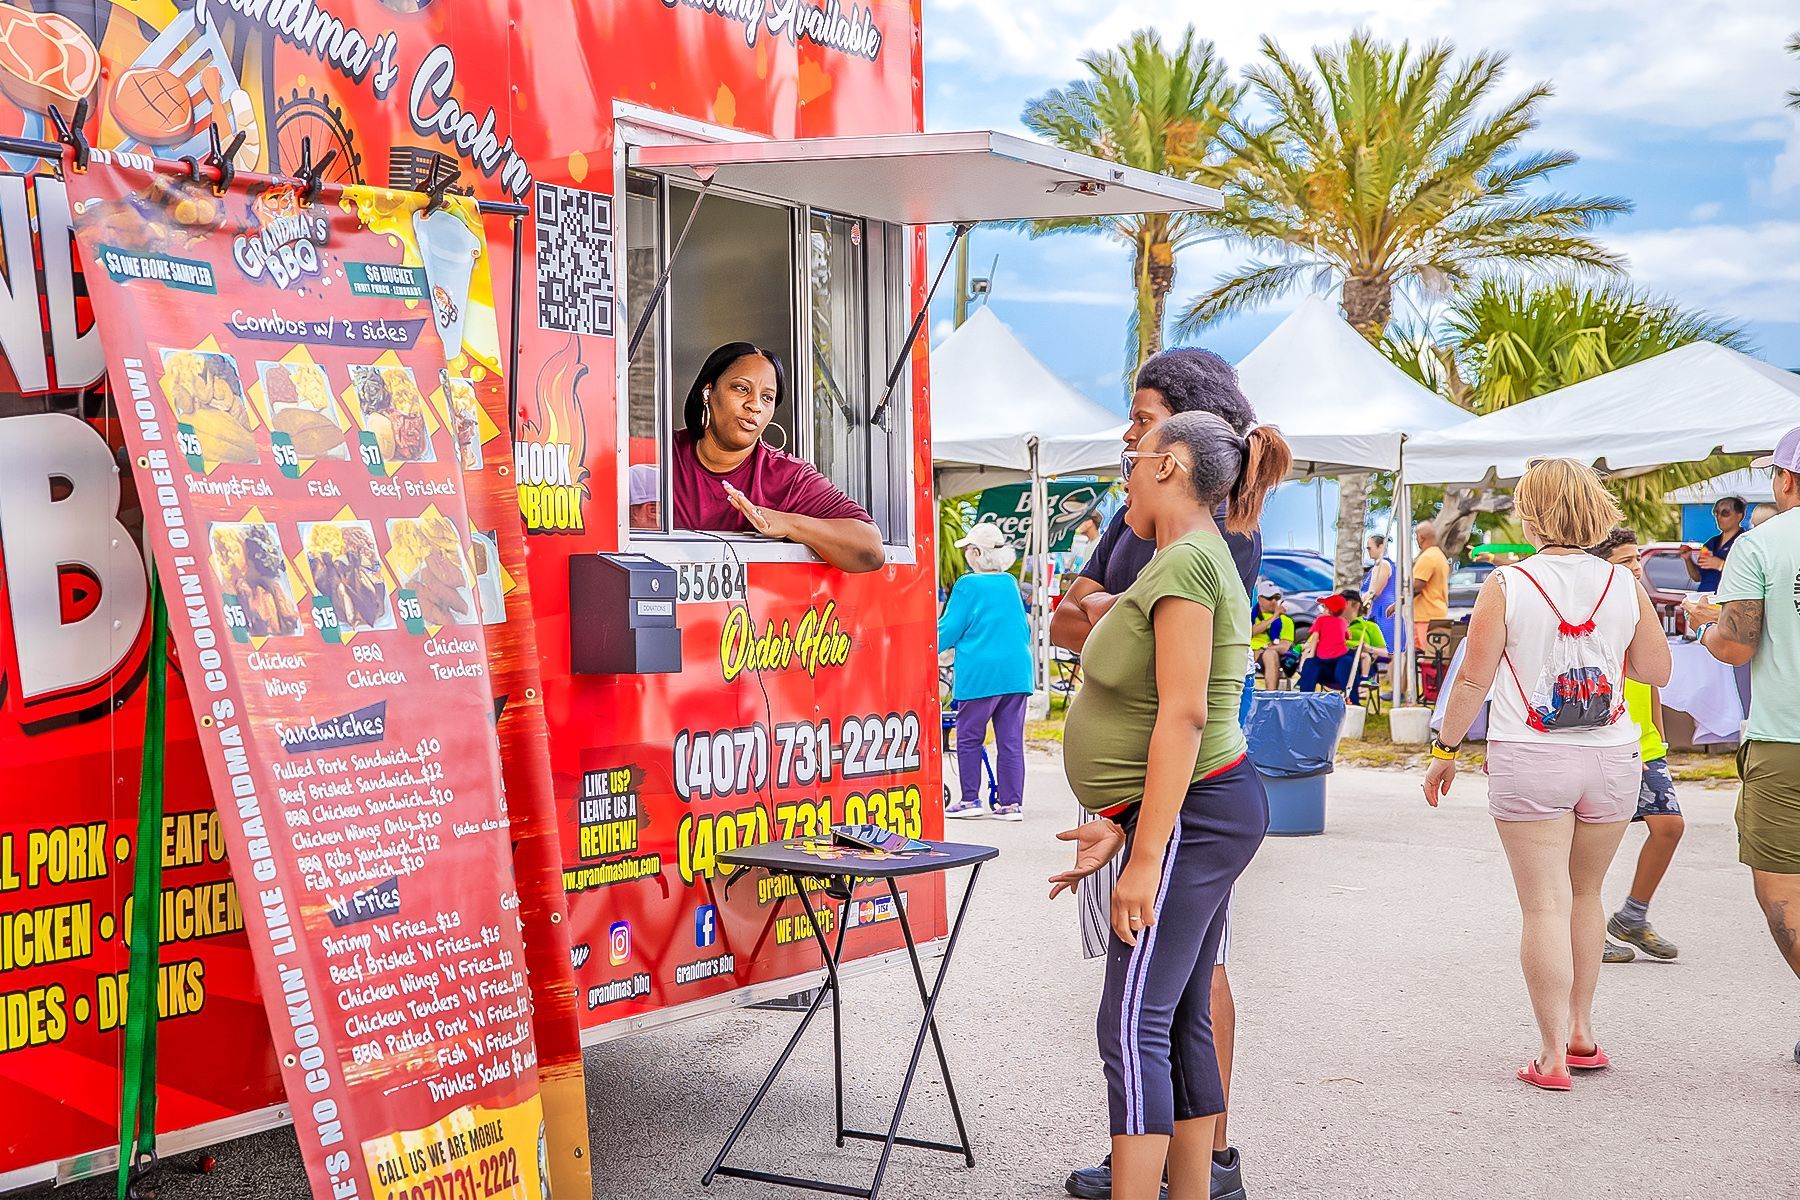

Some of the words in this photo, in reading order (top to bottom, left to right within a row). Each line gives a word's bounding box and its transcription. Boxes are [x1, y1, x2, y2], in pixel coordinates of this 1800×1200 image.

[120, 256, 141, 277] ONE
[140, 257, 171, 281] BONE
[170, 261, 213, 287] SAMPLER
[265, 239, 318, 290] BBQ
[379, 266, 415, 285] BUCKET
[231, 308, 308, 336] Combos
[313, 316, 334, 340] w/
[342, 320, 356, 340] 2
[362, 318, 408, 343] sides
[122, 357, 163, 442] NOW!
[177, 432, 202, 456] $25
[272, 444, 298, 467] $15
[147, 449, 191, 549] ORDER
[306, 478, 341, 497] Fish
[369, 475, 401, 501] Beef
[403, 478, 456, 498] Brisket
[527, 485, 584, 530] BOOK
[222, 604, 247, 629] $15
[311, 606, 338, 631] $15
[397, 598, 422, 621] $15
[352, 643, 385, 663] BBQ
[423, 637, 480, 657] Chicken
[719, 604, 794, 682] Order
[794, 599, 851, 679] Here
[247, 651, 307, 672] Chicken
[429, 659, 484, 681] Tenders
[264, 677, 308, 702] Wings
[346, 669, 408, 690] Chicken
[275, 713, 384, 747] Sandwiches
[272, 758, 316, 781] Pulled
[316, 758, 348, 776] Pork
[674, 725, 768, 799] (407)
[774, 712, 921, 787] 731-2222
[211, 698, 278, 883] GRANDMA'S
[278, 781, 307, 806] Beef
[308, 778, 354, 801] Brisket
[584, 772, 609, 798] LIKE
[609, 768, 631, 794] US?
[284, 808, 312, 828] BBQ
[311, 803, 365, 823] Chicken
[579, 797, 612, 824] LEAVE
[613, 795, 627, 819] US
[628, 794, 637, 816] A
[291, 830, 345, 851] Chicken
[344, 823, 382, 844] Wings
[579, 818, 637, 858] REVIEW!
[28, 823, 108, 887] PORK
[297, 854, 324, 875] BBQ
[324, 847, 353, 870] Ribs
[304, 867, 334, 892] Fish
[352, 887, 401, 915] Fries
[258, 885, 297, 957] LIKE
[775, 917, 792, 945] WE
[321, 933, 372, 959] Shrimp
[329, 953, 363, 984] Beef
[366, 944, 418, 976] Brisket
[337, 984, 400, 1011] Chicken
[400, 971, 440, 995] Wings
[345, 1010, 407, 1038] Chicken
[406, 991, 461, 1020] Tenders
[351, 1040, 385, 1066] BBQ
[385, 1022, 436, 1056] Pulled
[435, 1016, 469, 1041] Pork
[436, 1043, 468, 1069] Fish
[477, 1055, 511, 1088] Sodas
[312, 1098, 344, 1148] NO
[376, 1156, 409, 1187] CALL
[408, 1148, 428, 1174] US
[426, 1141, 448, 1168] WE
[447, 1133, 469, 1161] ARE
[468, 1118, 504, 1153] MOBILE
